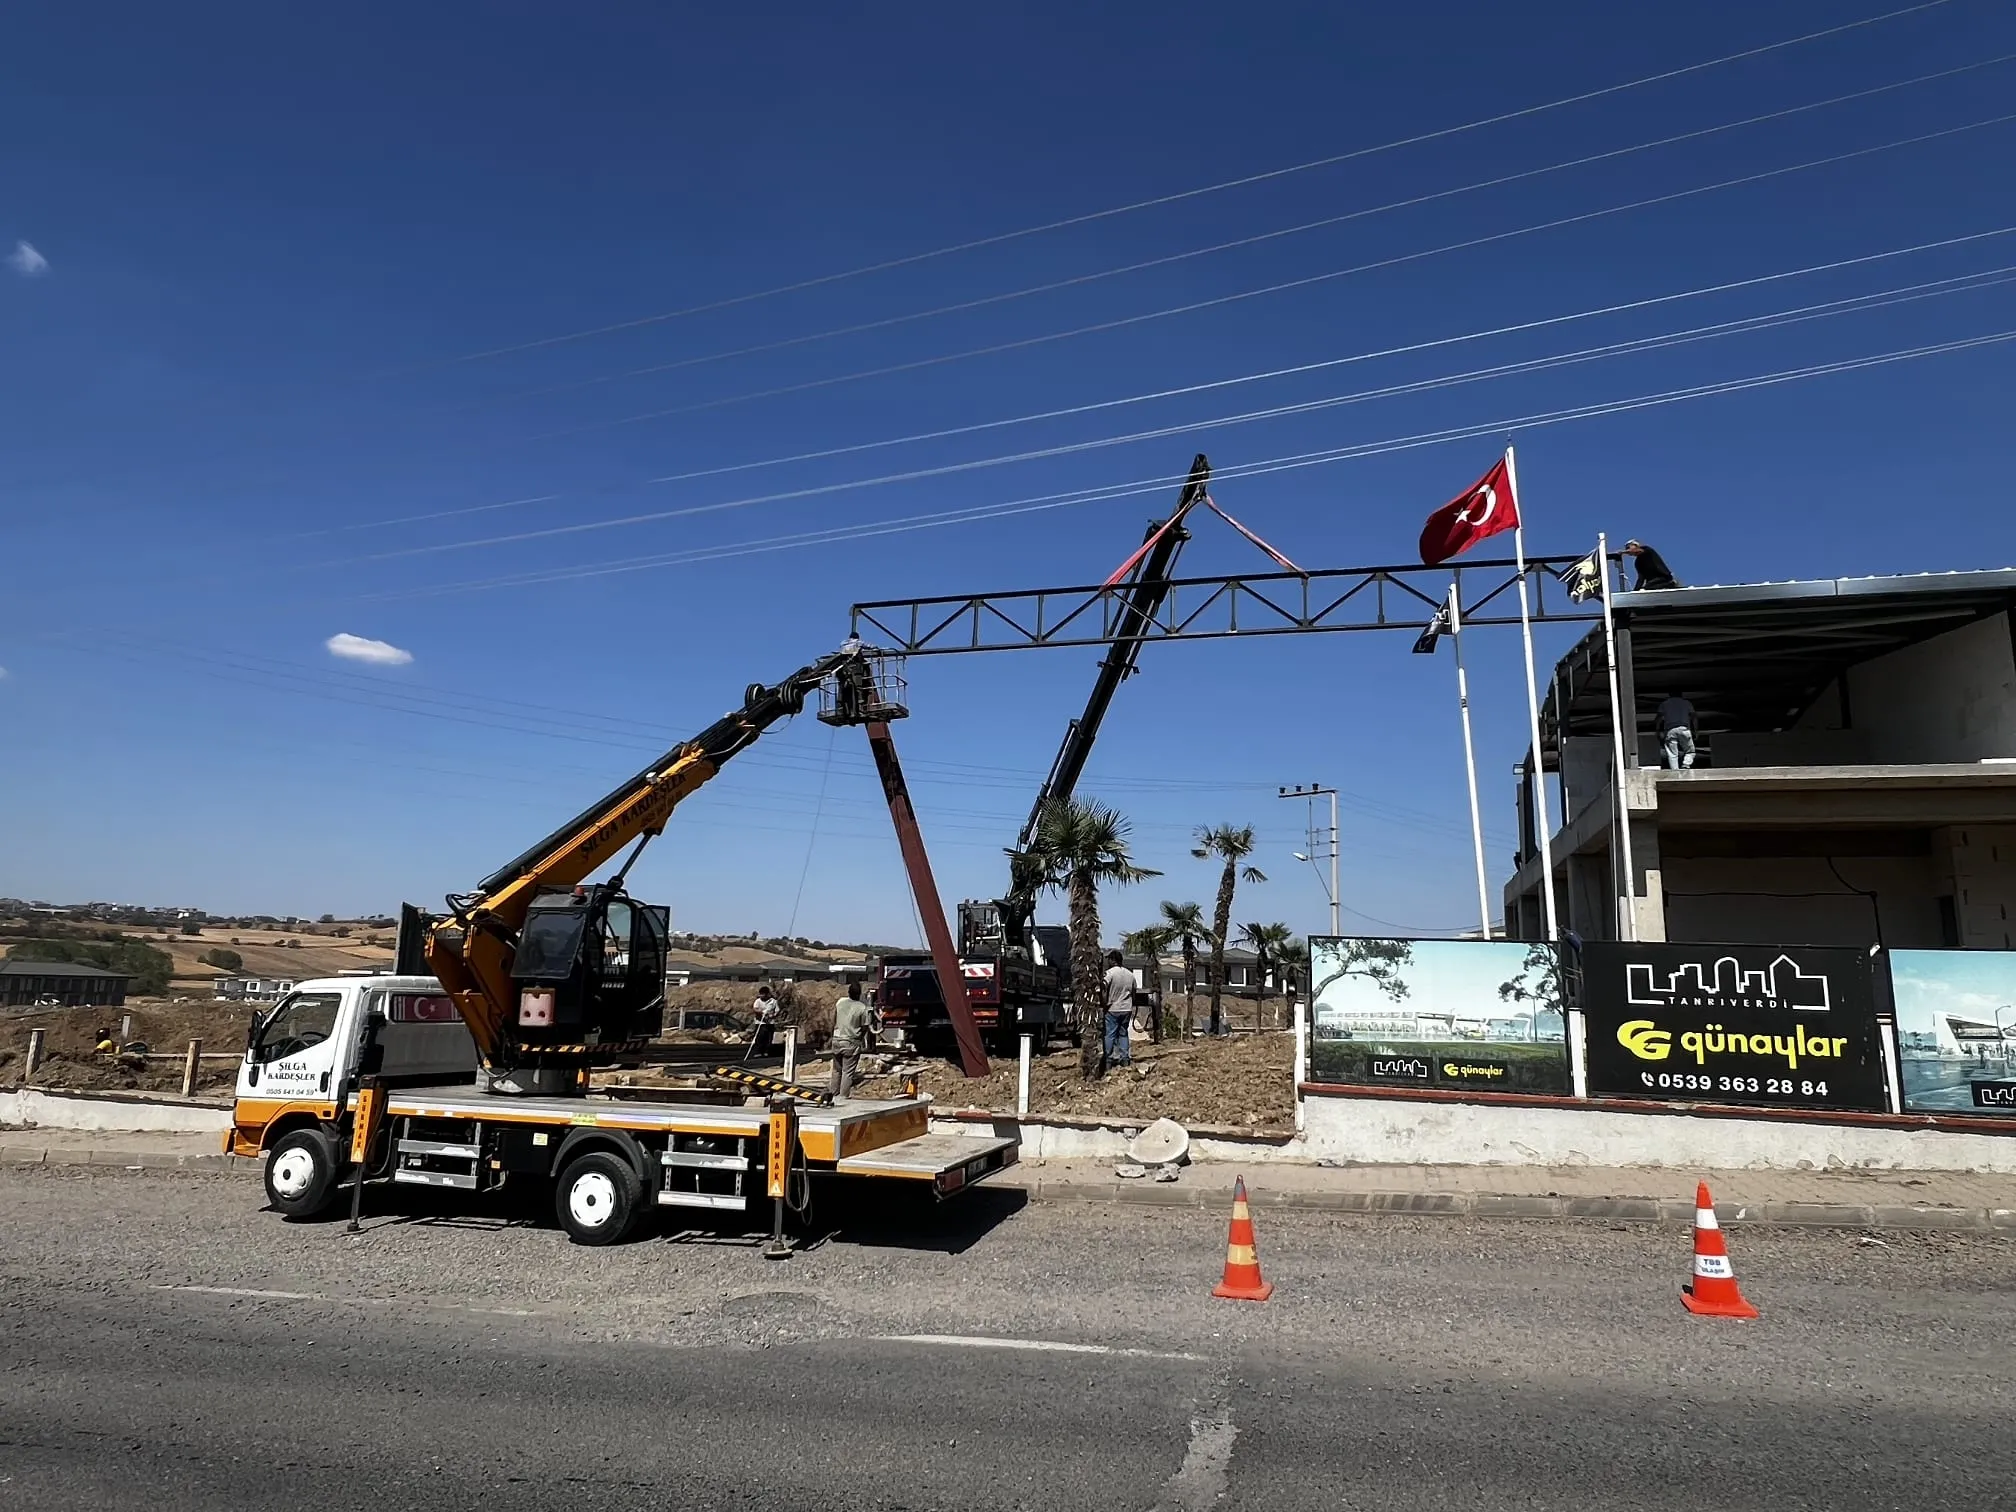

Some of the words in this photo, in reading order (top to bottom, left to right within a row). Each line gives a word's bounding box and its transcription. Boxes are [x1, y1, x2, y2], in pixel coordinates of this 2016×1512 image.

[1658, 1073, 1712, 1090] 0539
[1718, 1076, 1760, 1093] 363
[1766, 1078, 1794, 1095] 28
[1801, 1080, 1829, 1096] 84
